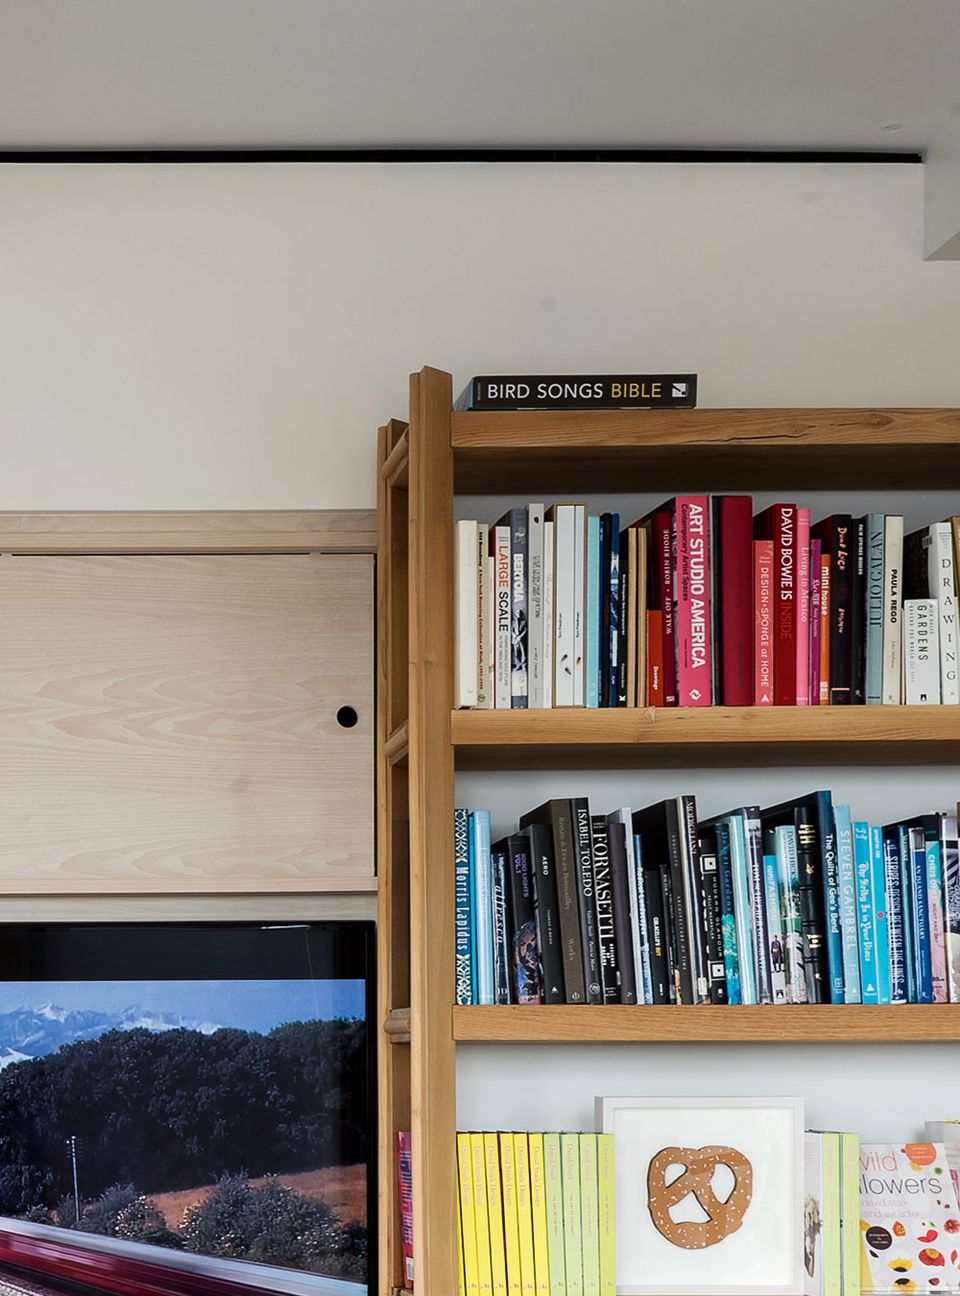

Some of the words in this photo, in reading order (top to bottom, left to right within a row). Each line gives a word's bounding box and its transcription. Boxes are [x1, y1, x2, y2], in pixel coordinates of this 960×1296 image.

[487, 383, 530, 399] BIRD
[537, 383, 603, 399] SONGS
[611, 383, 662, 398] BIBLE
[680, 503, 689, 553] Contemporary
[689, 503, 703, 535] ART
[780, 508, 793, 546] DAVID
[662, 528, 670, 557] RHODE
[499, 545, 509, 588] LARGE
[682, 555, 690, 575] Artist
[690, 537, 704, 595] STUDIO
[780, 548, 793, 588] BOWIE
[799, 546, 809, 575] Living
[513, 553, 524, 603] BERTOIA
[681, 577, 690, 601] Spaces
[801, 577, 808, 587] in
[821, 566, 830, 589] mini
[780, 590, 793, 600] IS
[800, 588, 809, 622] Mexico
[820, 590, 829, 616] house
[498, 591, 509, 632] SCALE
[780, 602, 792, 640] INSIDE
[890, 599, 898, 624] REGO
[942, 559, 956, 681] DRAWING
[691, 598, 706, 669] AMERICA
[917, 605, 929, 661] GARDENS
[652, 665, 660, 690] Drawings
[578, 809, 589, 847] ISABEL
[685, 801, 697, 857] MODIGLIANI
[787, 830, 796, 855] DAVID
[825, 833, 834, 849] The
[514, 853, 522, 874] VOL.1
[520, 853, 528, 872] 1000
[720, 831, 730, 866] Desert
[825, 851, 836, 876] Quilts
[840, 829, 853, 880] STEVEN
[541, 855, 549, 876] AERO
[581, 848, 593, 897] TOLEDO
[788, 856, 797, 882] HICKS
[828, 877, 836, 886] of
[928, 854, 937, 879] CHRIS
[456, 867, 469, 902] Morris
[521, 872, 530, 898] LIGHTS
[593, 833, 614, 939] FORNASETTI
[711, 876, 720, 913] MODERN
[723, 869, 733, 913] Gardens
[829, 887, 838, 911] Gee's
[929, 879, 938, 899] OFILI
[455, 907, 470, 950] Lapidus
[494, 885, 507, 944] alfresco
[830, 912, 839, 933] Bend
[843, 884, 857, 950] GAMBREL
[653, 917, 662, 946] COLACELLO'S
[715, 916, 723, 958] GLAMOUR
